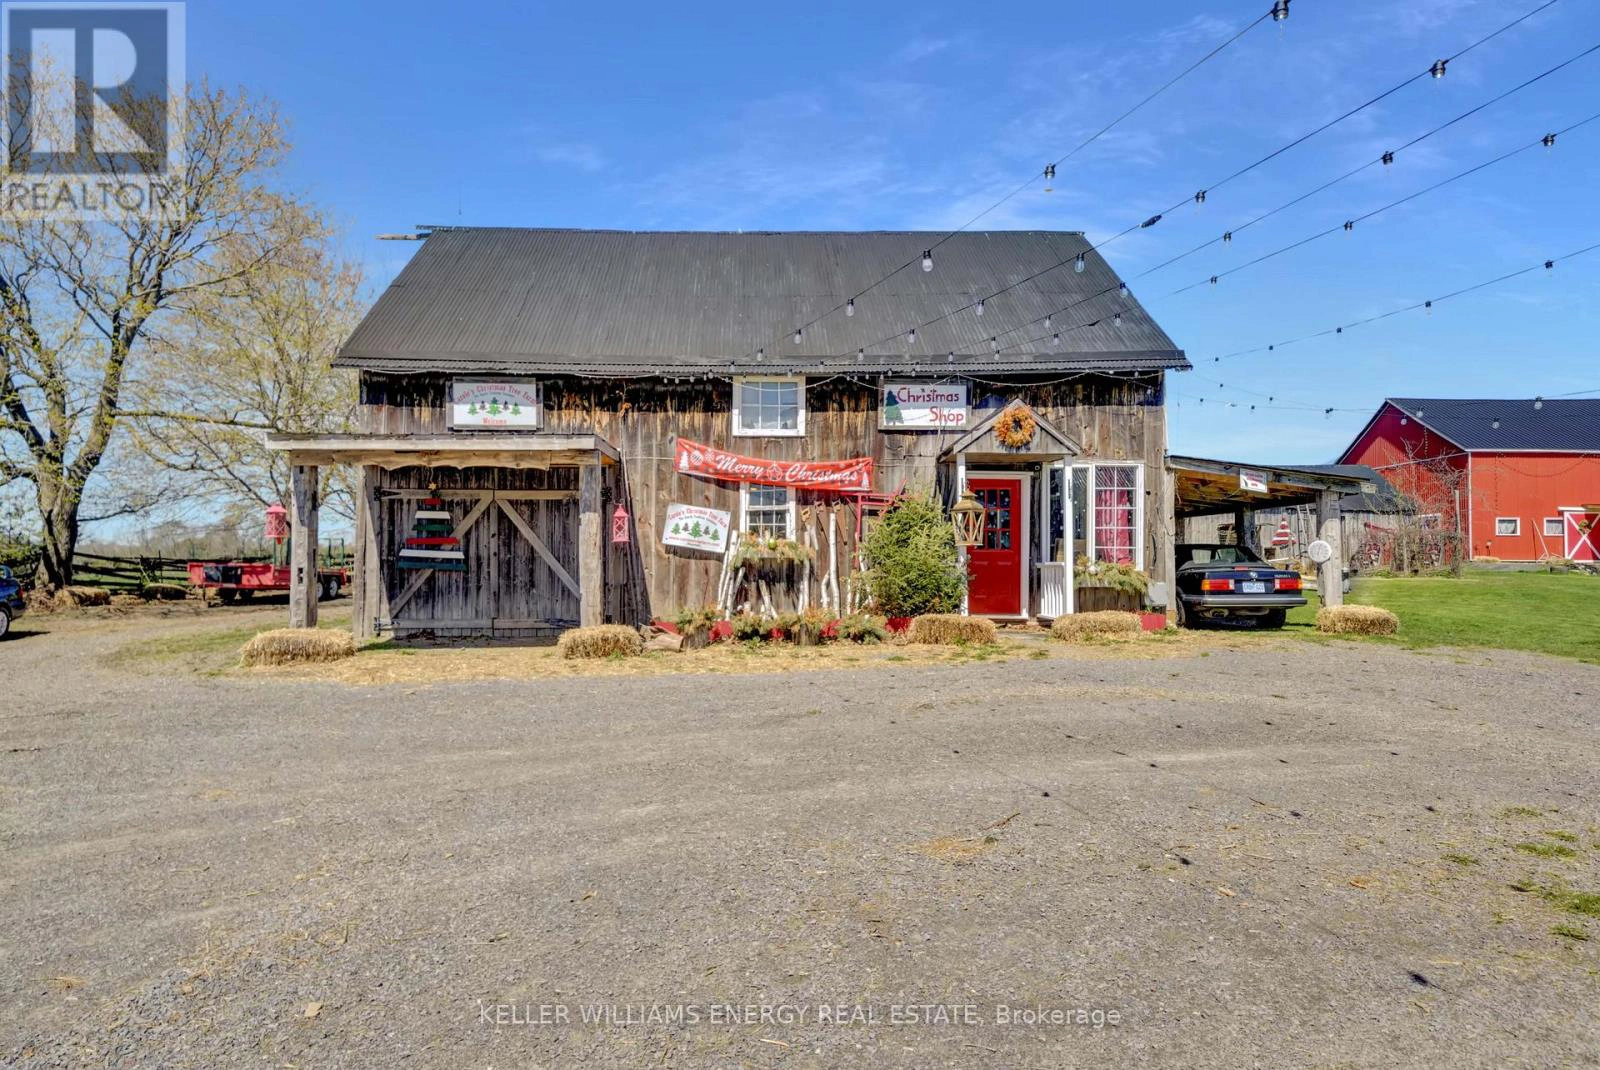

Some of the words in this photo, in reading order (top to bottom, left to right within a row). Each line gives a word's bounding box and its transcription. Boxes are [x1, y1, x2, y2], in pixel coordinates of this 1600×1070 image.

[897, 387, 960, 403] Christmas
[929, 406, 964, 425] Shop
[714, 454, 765, 480] Merry
[785, 464, 858, 482] Christmas
